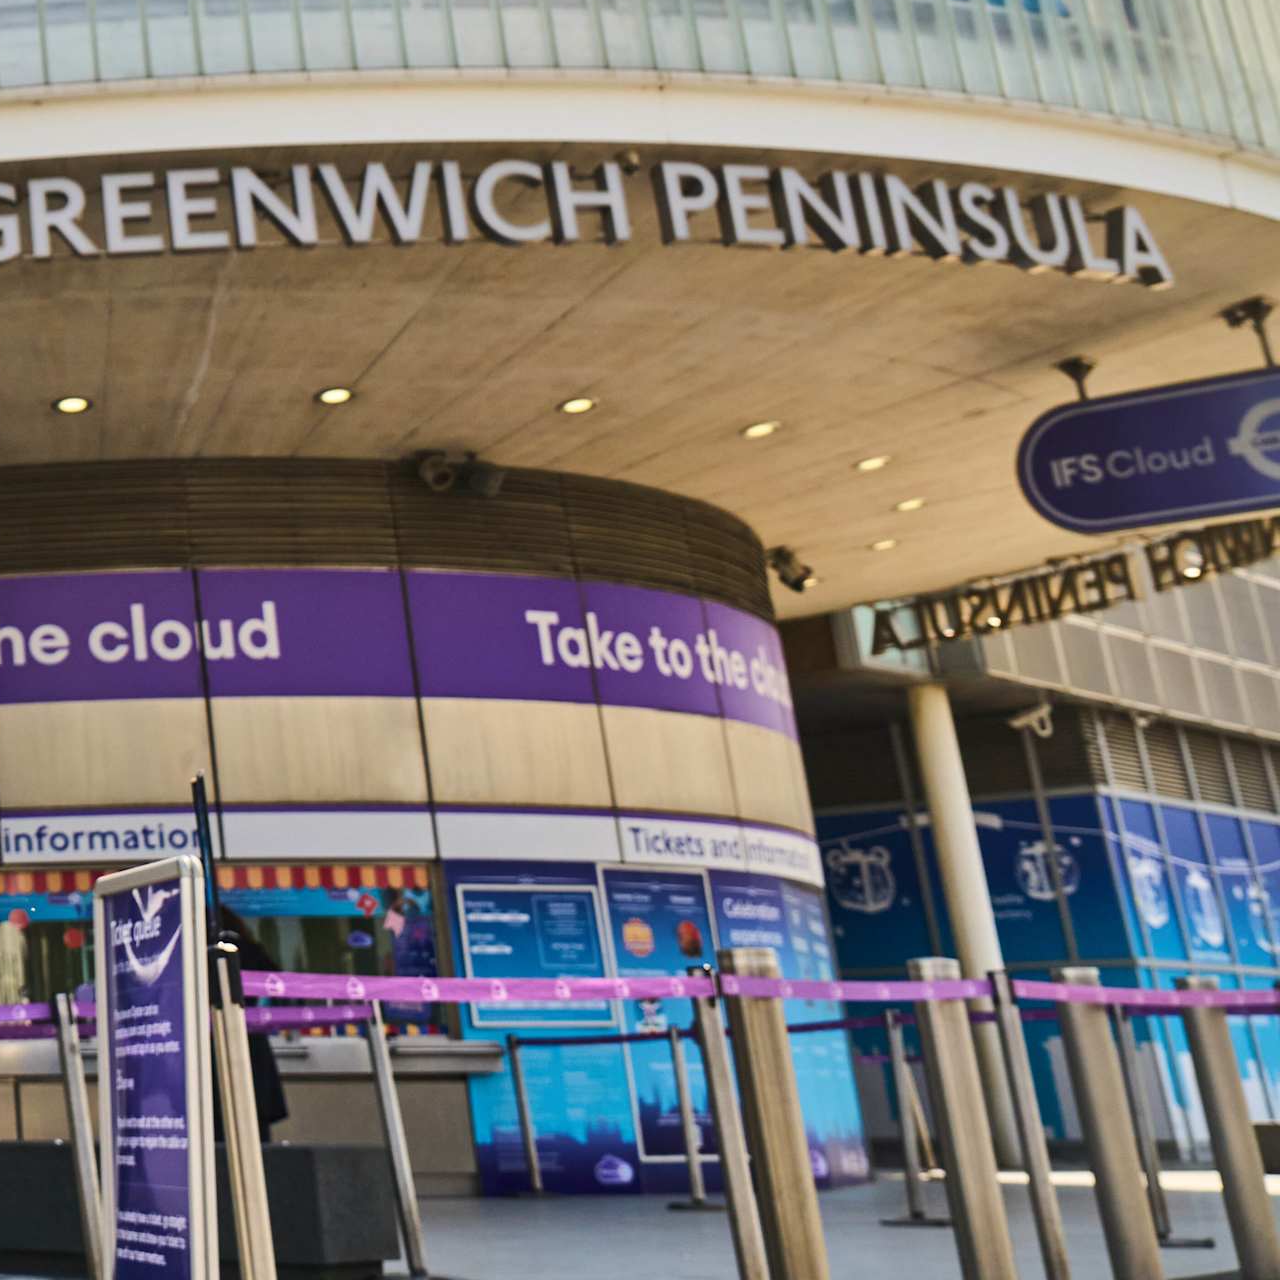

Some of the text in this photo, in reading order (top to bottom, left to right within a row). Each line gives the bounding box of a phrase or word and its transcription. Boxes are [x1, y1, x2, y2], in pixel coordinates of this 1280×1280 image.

[652, 161, 1175, 290] PENINSULA
[1050, 435, 1216, 488] IFS Cloud
[88, 600, 282, 662] cloud
[524, 610, 644, 673] Take
[648, 625, 693, 679] to
[695, 628, 748, 690] the
[629, 826, 705, 857] Tickets
